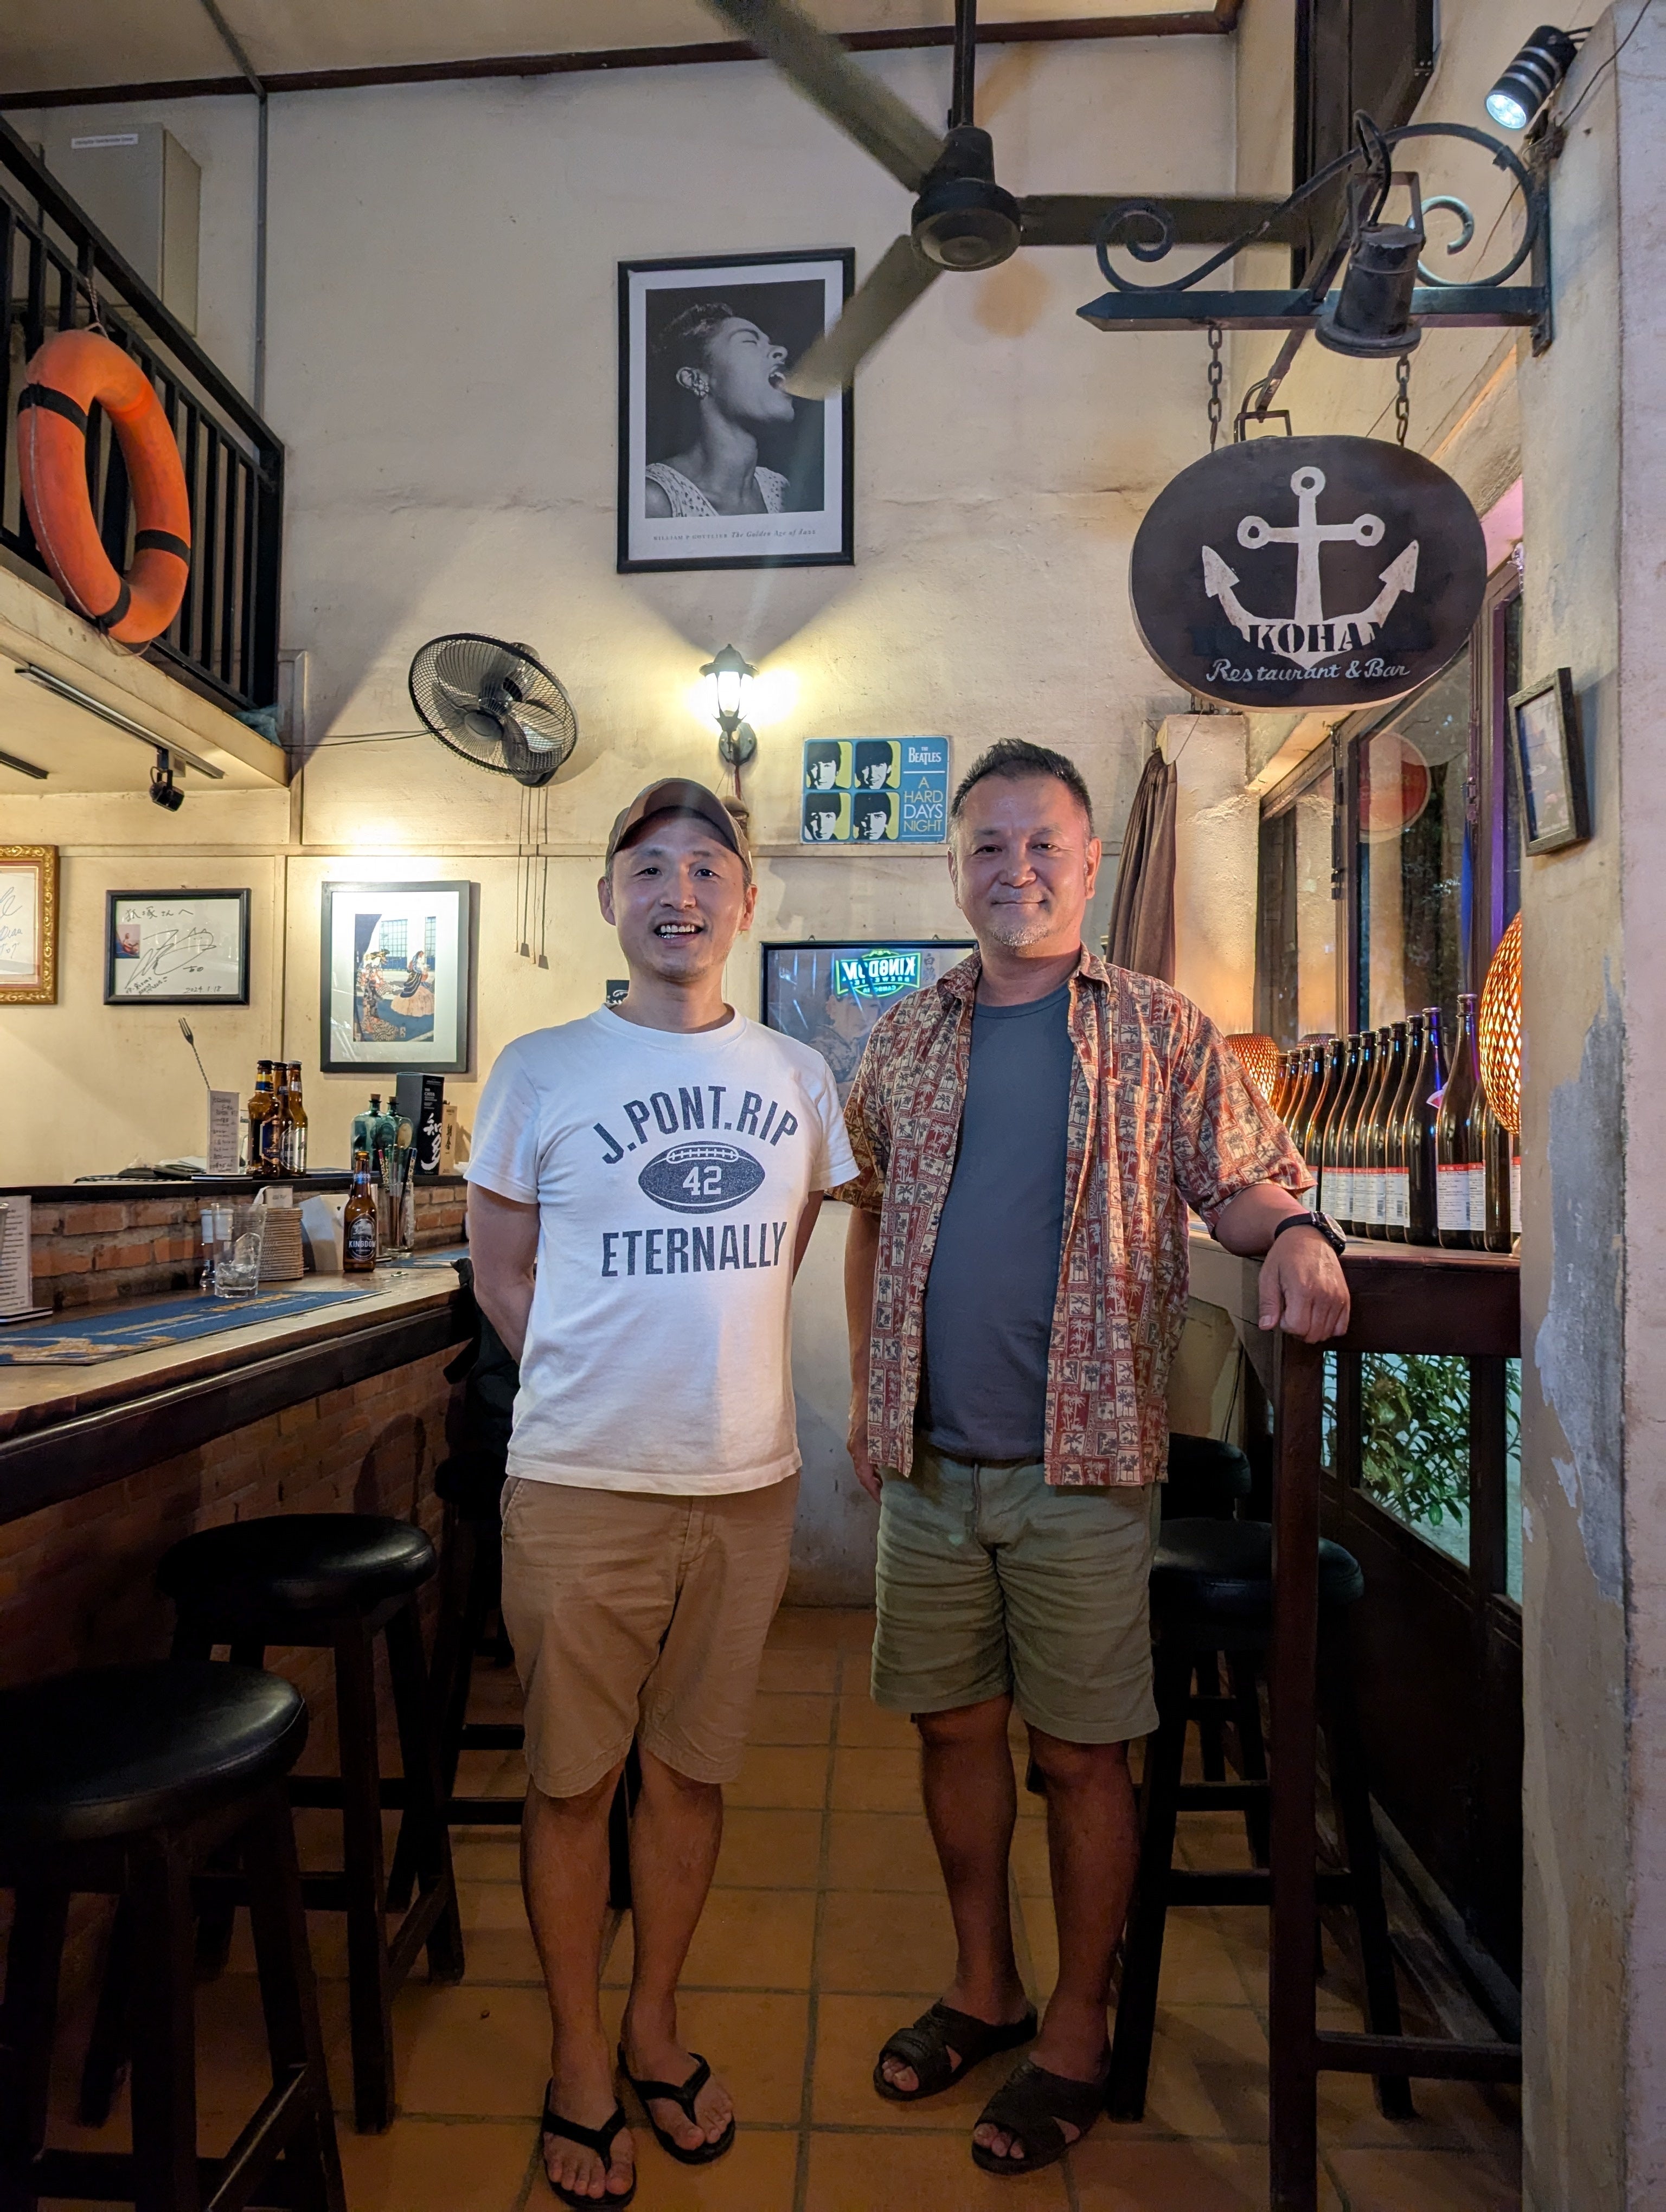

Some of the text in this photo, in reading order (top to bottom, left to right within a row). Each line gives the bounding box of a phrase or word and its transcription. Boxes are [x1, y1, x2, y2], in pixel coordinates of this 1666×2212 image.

[789, 529, 797, 537] of
[1206, 657, 1411, 682] Restaurant & Bar
[908, 747, 942, 765] BEATLES
[918, 776, 930, 789] A
[904, 790, 944, 803] HARD
[904, 803, 943, 820] DAYS
[904, 819, 943, 833] NIGHT
[682, 1165, 722, 1195] 42
[349, 1240, 376, 1248] KINGDOM
[601, 1221, 787, 1277] ETERNALLY
